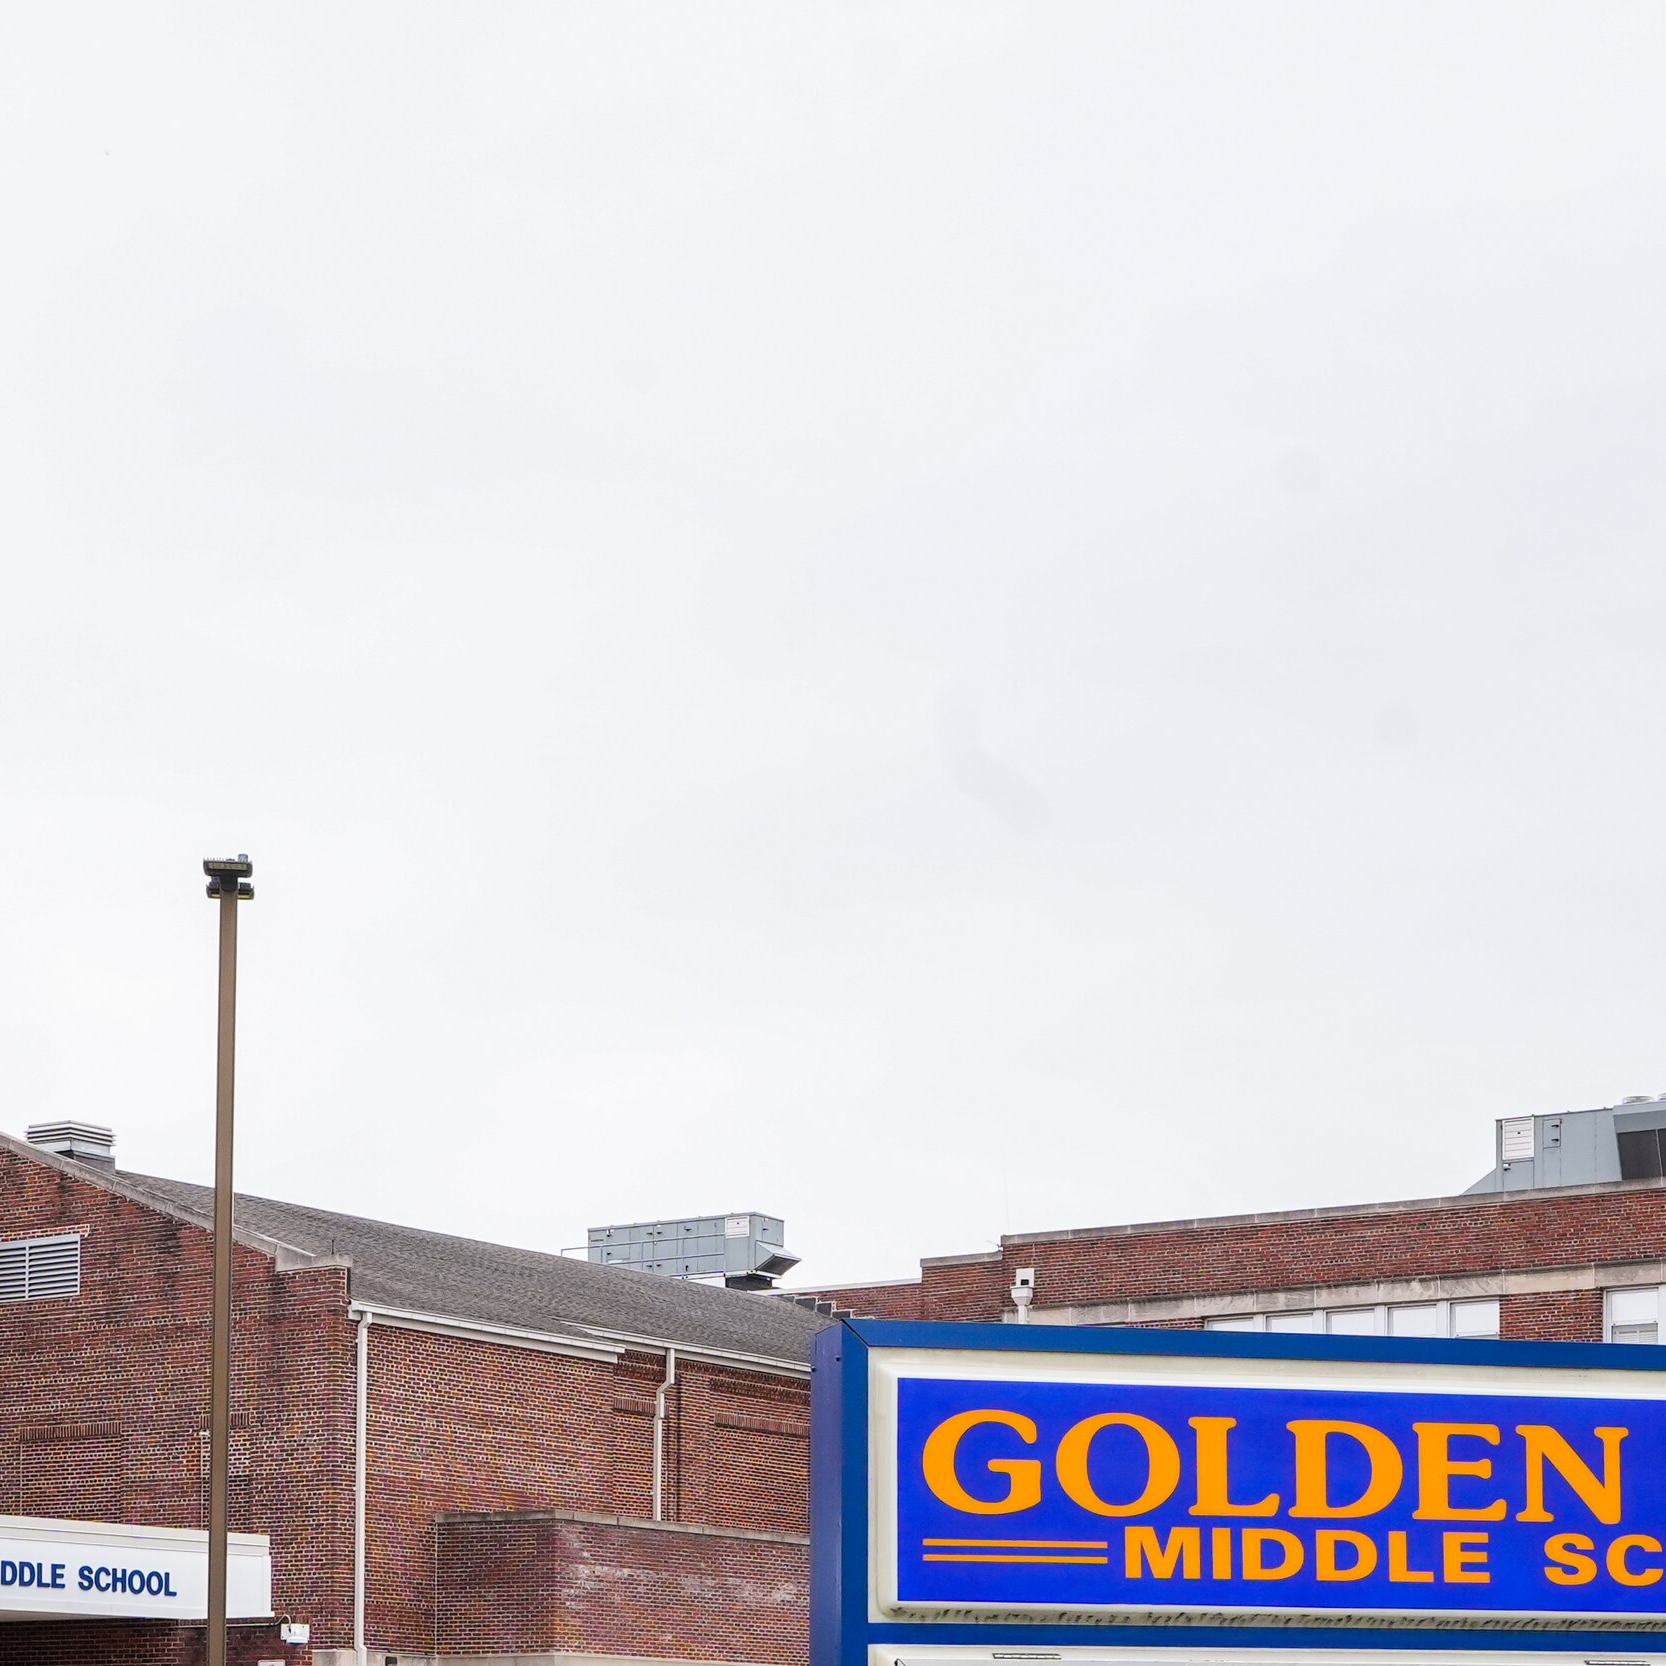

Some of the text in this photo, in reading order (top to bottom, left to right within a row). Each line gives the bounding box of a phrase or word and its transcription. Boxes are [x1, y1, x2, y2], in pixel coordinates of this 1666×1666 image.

[922, 1409, 1629, 1524] GOLDEN
[78, 1565, 179, 1598] SCHOOL
[1125, 1526, 1490, 1584] MIDDLE
